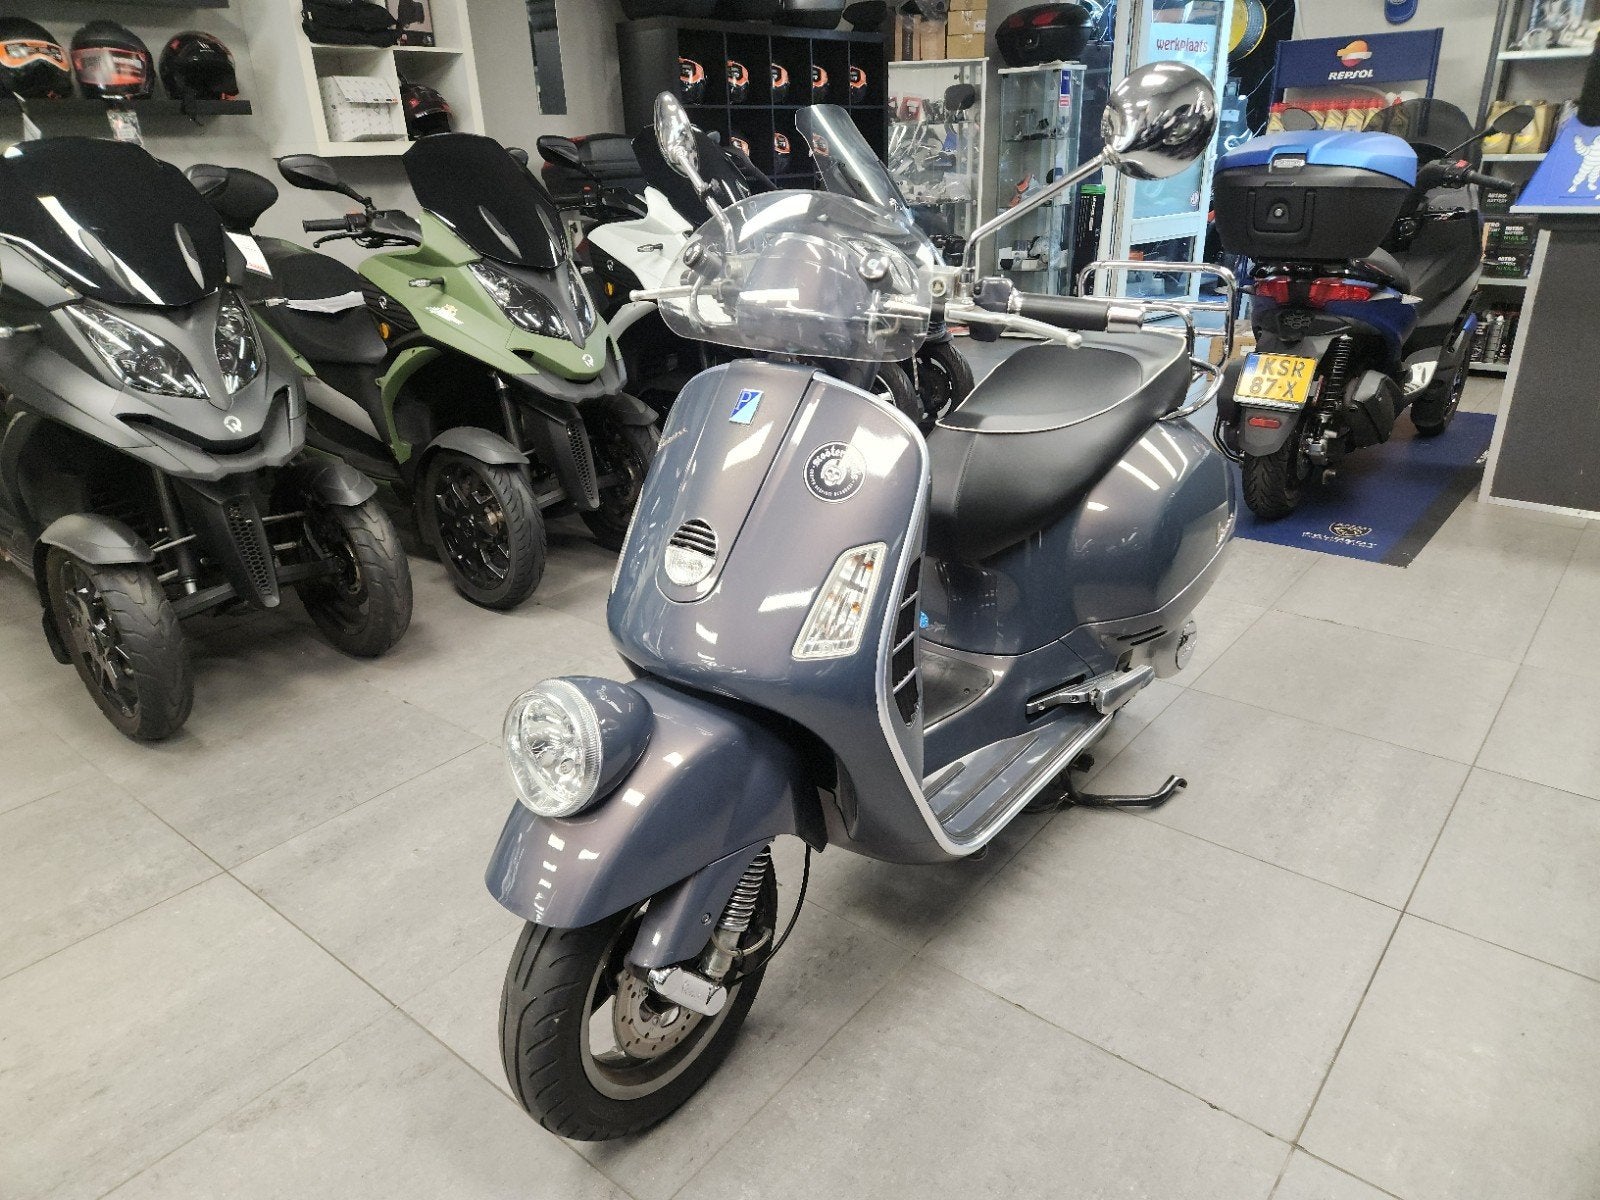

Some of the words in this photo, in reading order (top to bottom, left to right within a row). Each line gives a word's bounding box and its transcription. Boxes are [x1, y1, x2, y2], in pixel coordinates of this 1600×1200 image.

[1156, 37, 1208, 53] werkplaats
[1327, 69, 1374, 81] REPSOL
[1261, 357, 1305, 378] KSR
[1249, 376, 1298, 398] 87-X
